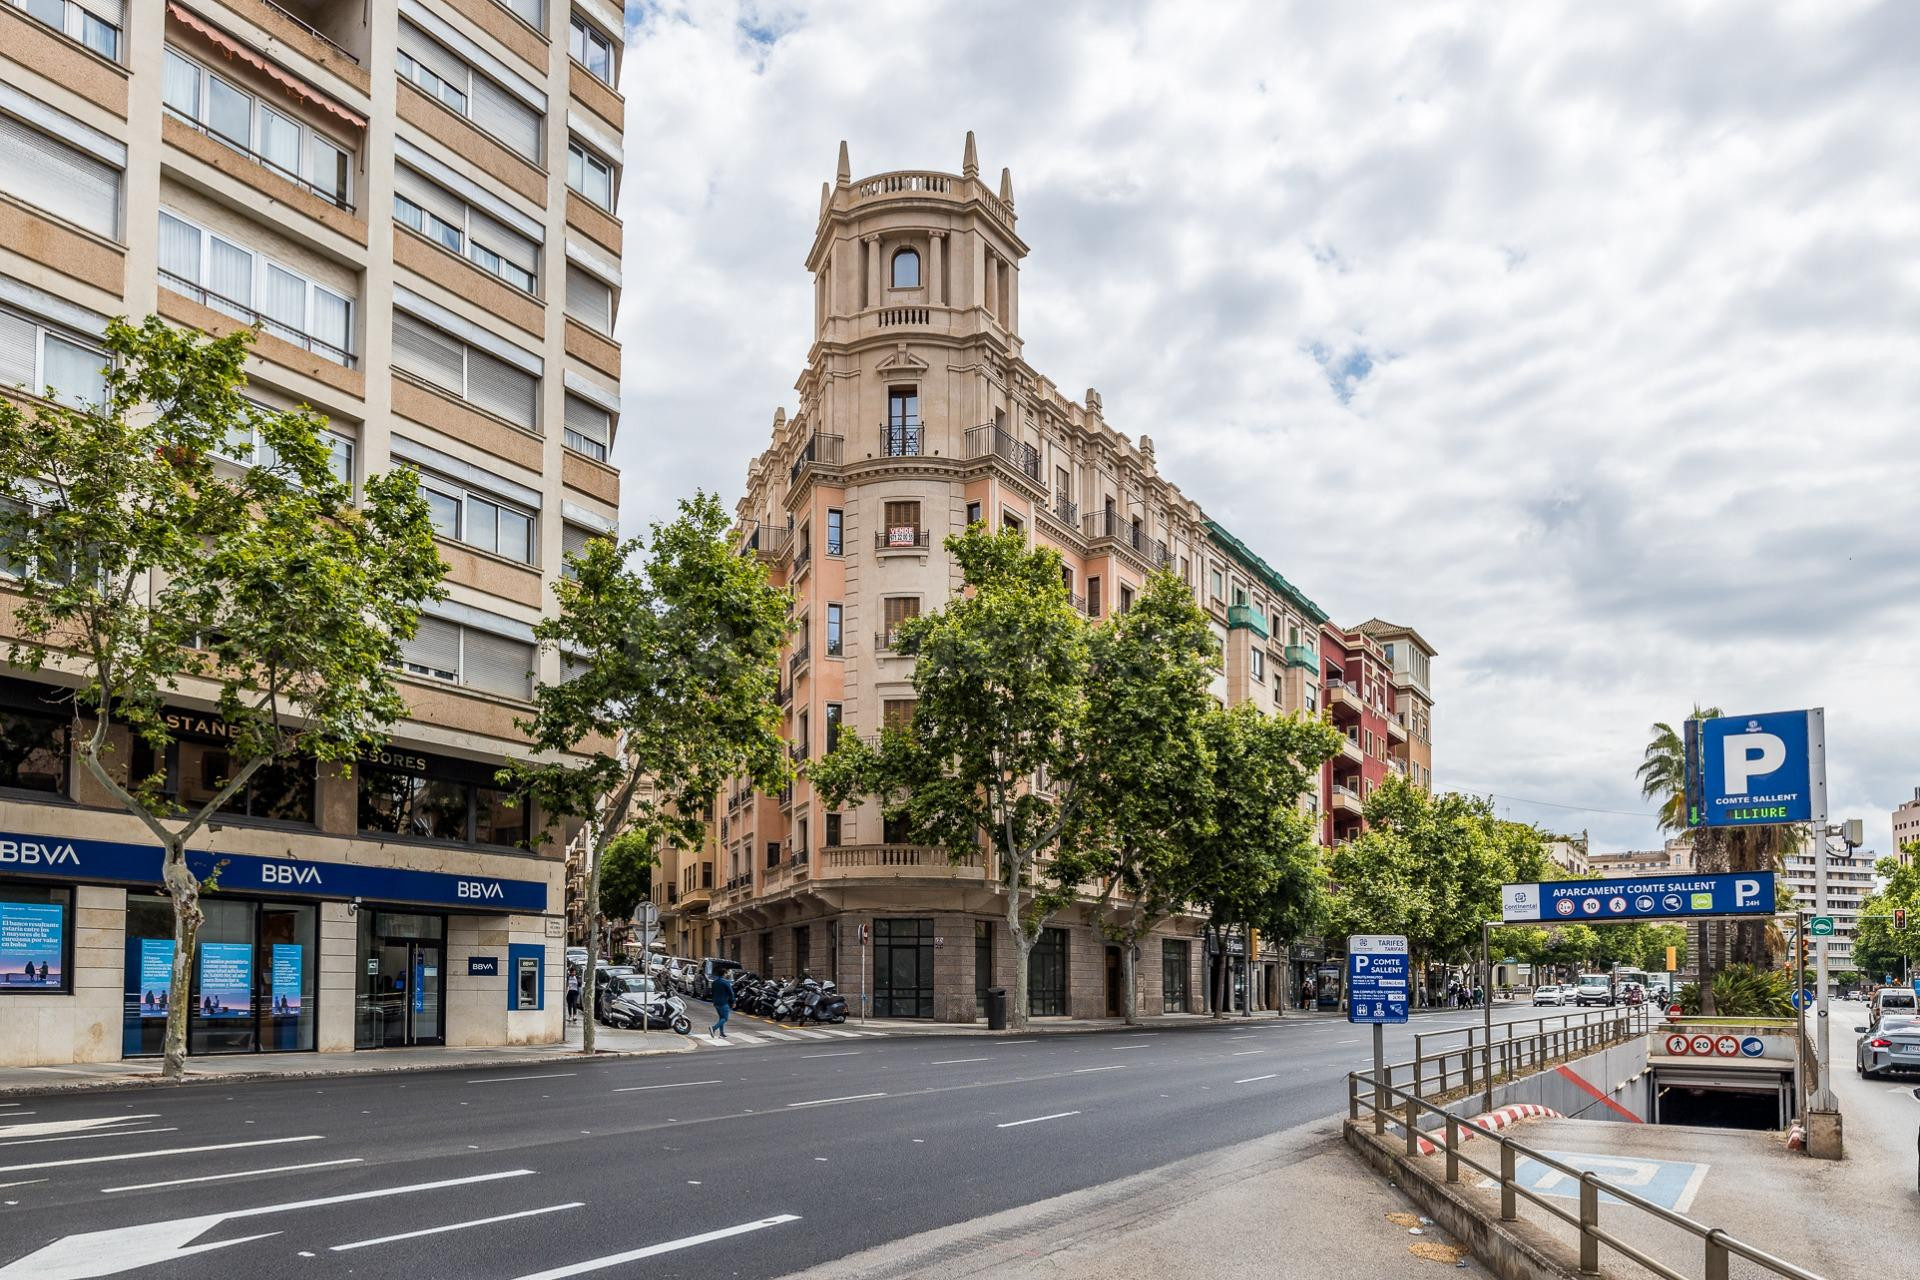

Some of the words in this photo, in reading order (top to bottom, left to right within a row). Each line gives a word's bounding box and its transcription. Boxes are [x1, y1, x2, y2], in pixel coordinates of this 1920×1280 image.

[1723, 733, 1786, 794] P
[1716, 796, 1750, 804] COMTE
[1752, 794, 1798, 802] SALLENT
[1734, 807, 1786, 819] LLIURE
[0, 840, 80, 865] BBVA
[262, 864, 322, 884] BBVA
[458, 881, 504, 899] BBVA
[1553, 886, 1625, 897] APARCAMENT
[1627, 884, 1665, 893] COMTE
[1668, 881, 1716, 892] SALLENT
[1735, 880, 1760, 906] P
[1356, 956, 1369, 972] P
